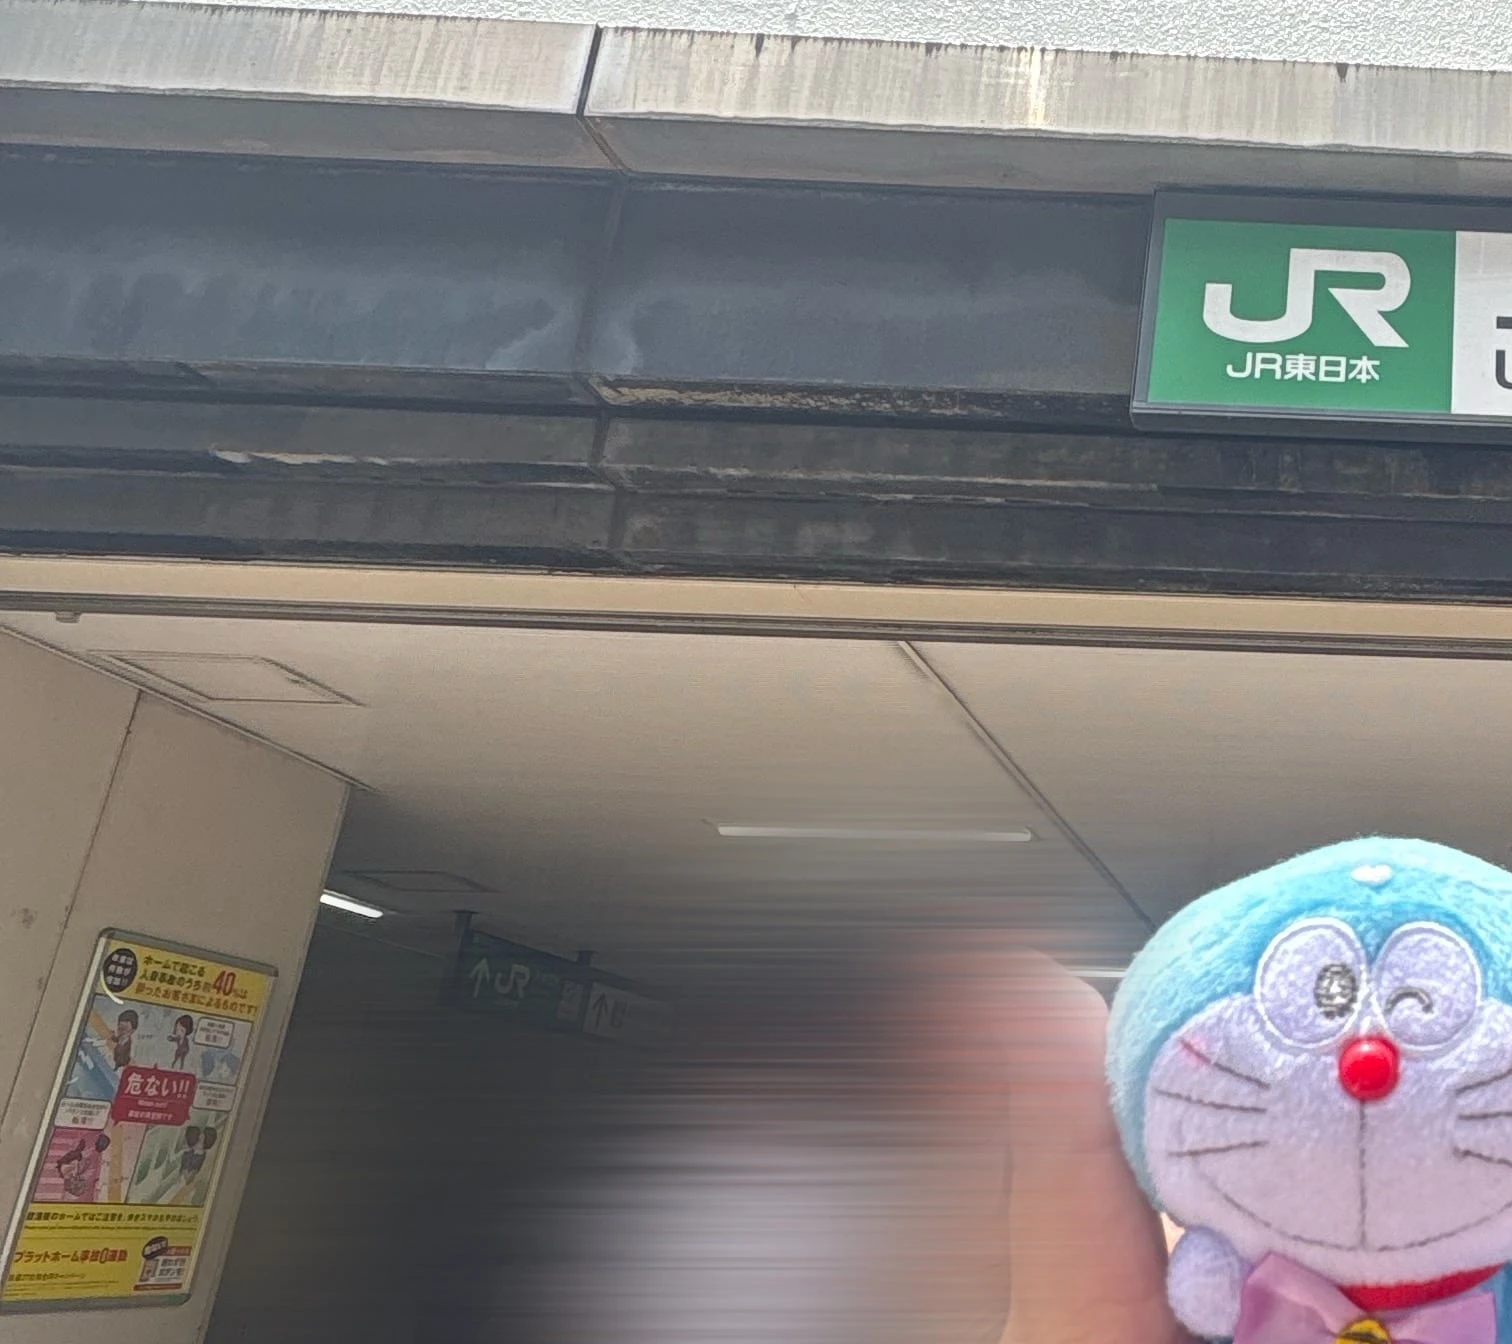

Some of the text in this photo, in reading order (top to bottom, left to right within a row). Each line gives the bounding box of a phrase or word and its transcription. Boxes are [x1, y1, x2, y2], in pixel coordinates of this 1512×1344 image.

[1202, 248, 1412, 348] JR
[1226, 352, 1380, 383] JR東日本
